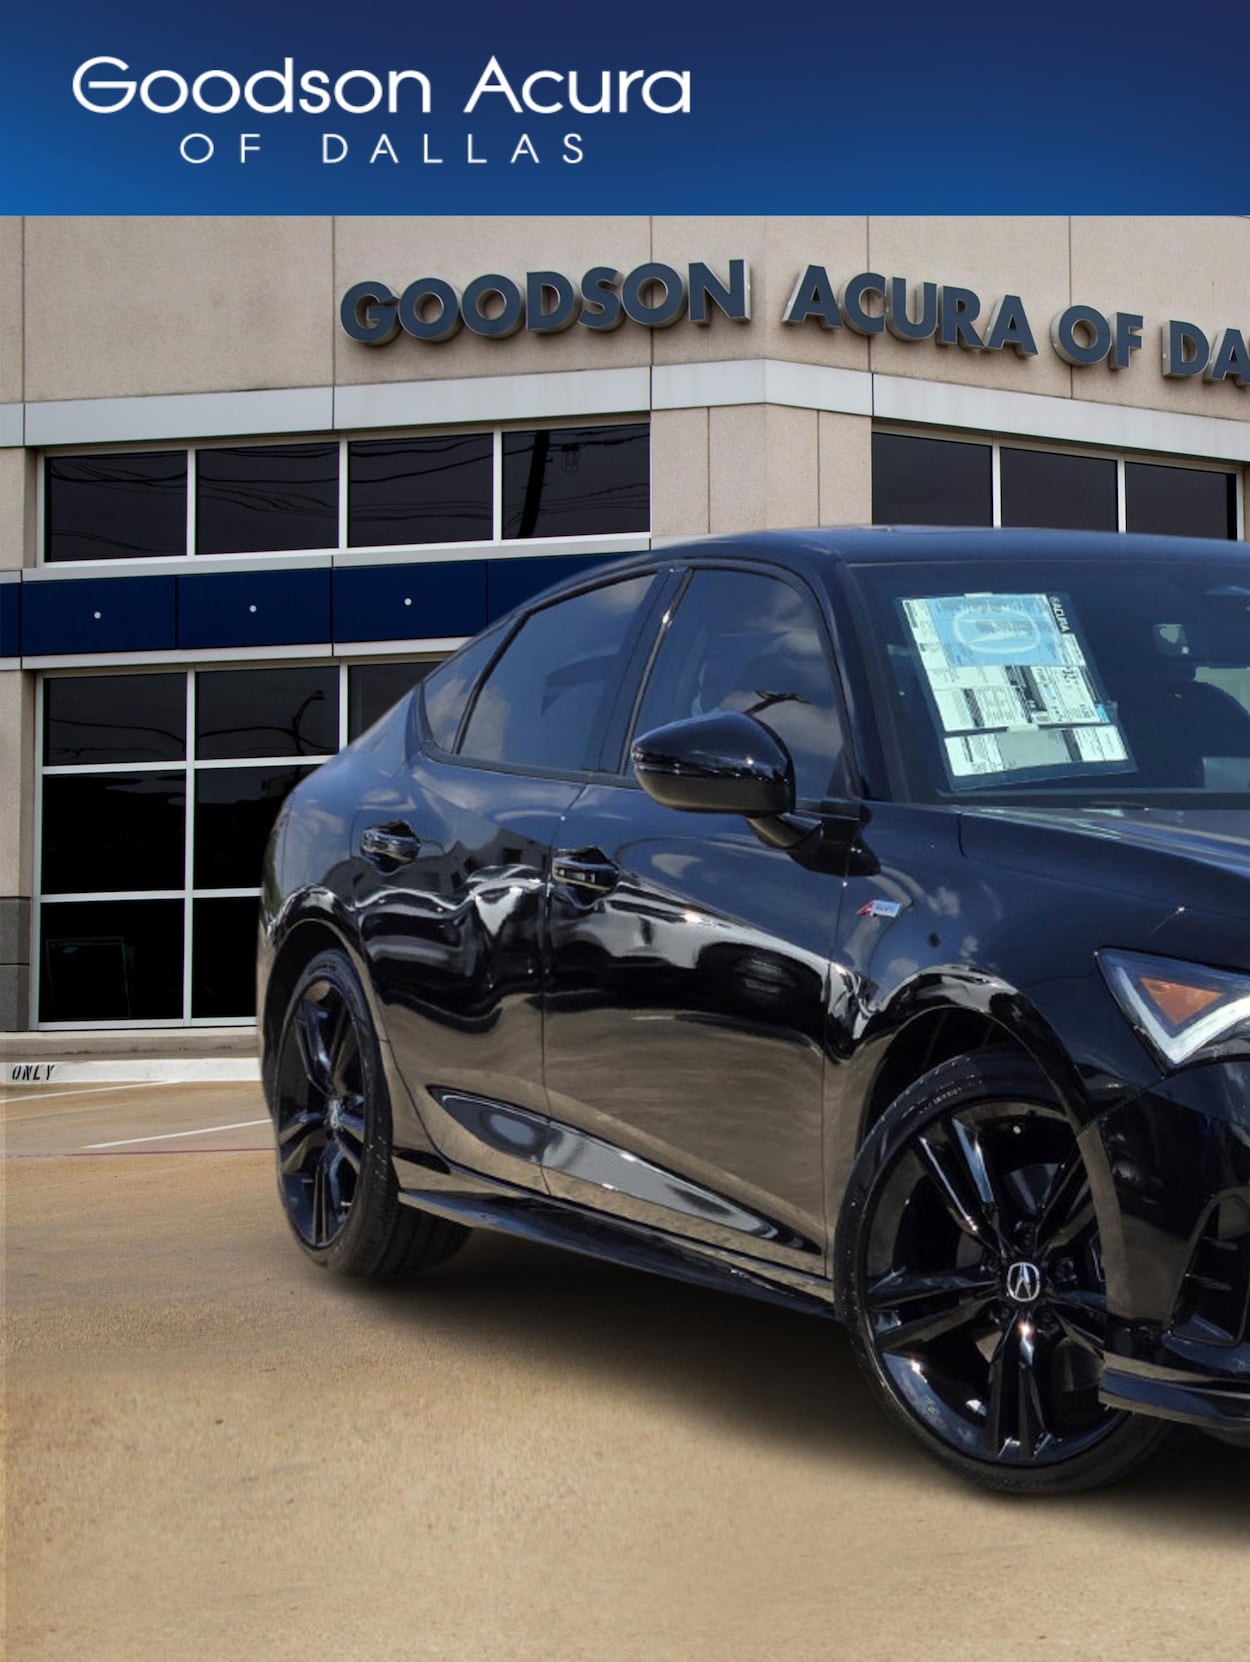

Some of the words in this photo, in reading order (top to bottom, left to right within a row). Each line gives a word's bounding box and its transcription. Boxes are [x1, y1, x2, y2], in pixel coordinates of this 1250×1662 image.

[340, 258, 752, 345] GOODSON
[782, 264, 1038, 356] ACURA
[1051, 304, 1143, 370] OF
[11, 1064, 56, 1081] ONLY
